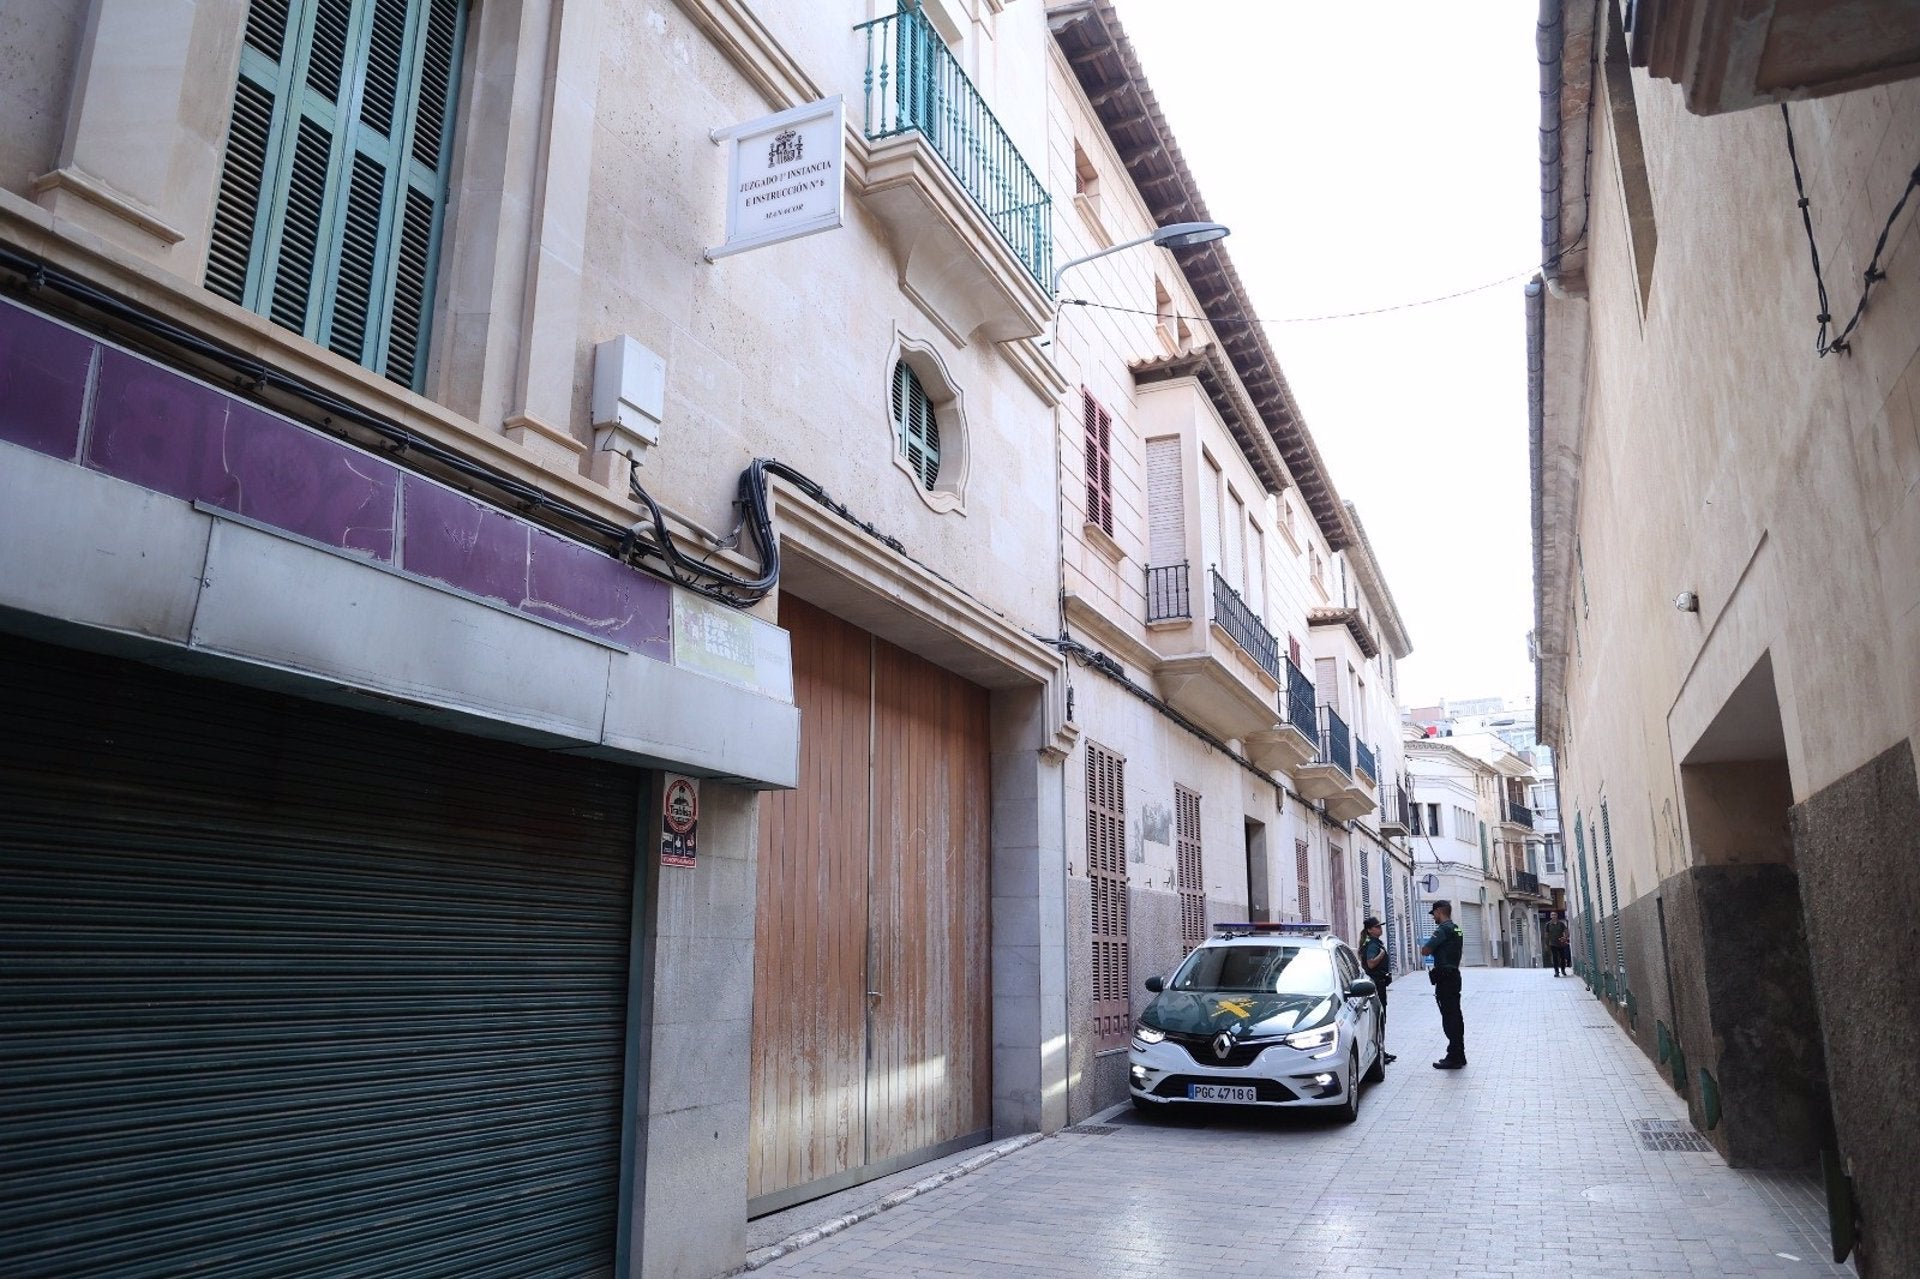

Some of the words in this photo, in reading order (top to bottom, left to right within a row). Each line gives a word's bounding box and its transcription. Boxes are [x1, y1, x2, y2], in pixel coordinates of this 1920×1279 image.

[740, 174, 778, 193] JUZGADO
[787, 160, 832, 179] INSTANCIA
[746, 198, 751, 207] E
[752, 181, 808, 205] INSTRUCCIÓN
[765, 203, 804, 219] MANACOR
[1195, 1086, 1215, 1099] PGC
[1217, 1087, 1244, 1100] 4718
[1246, 1088, 1254, 1101] G
